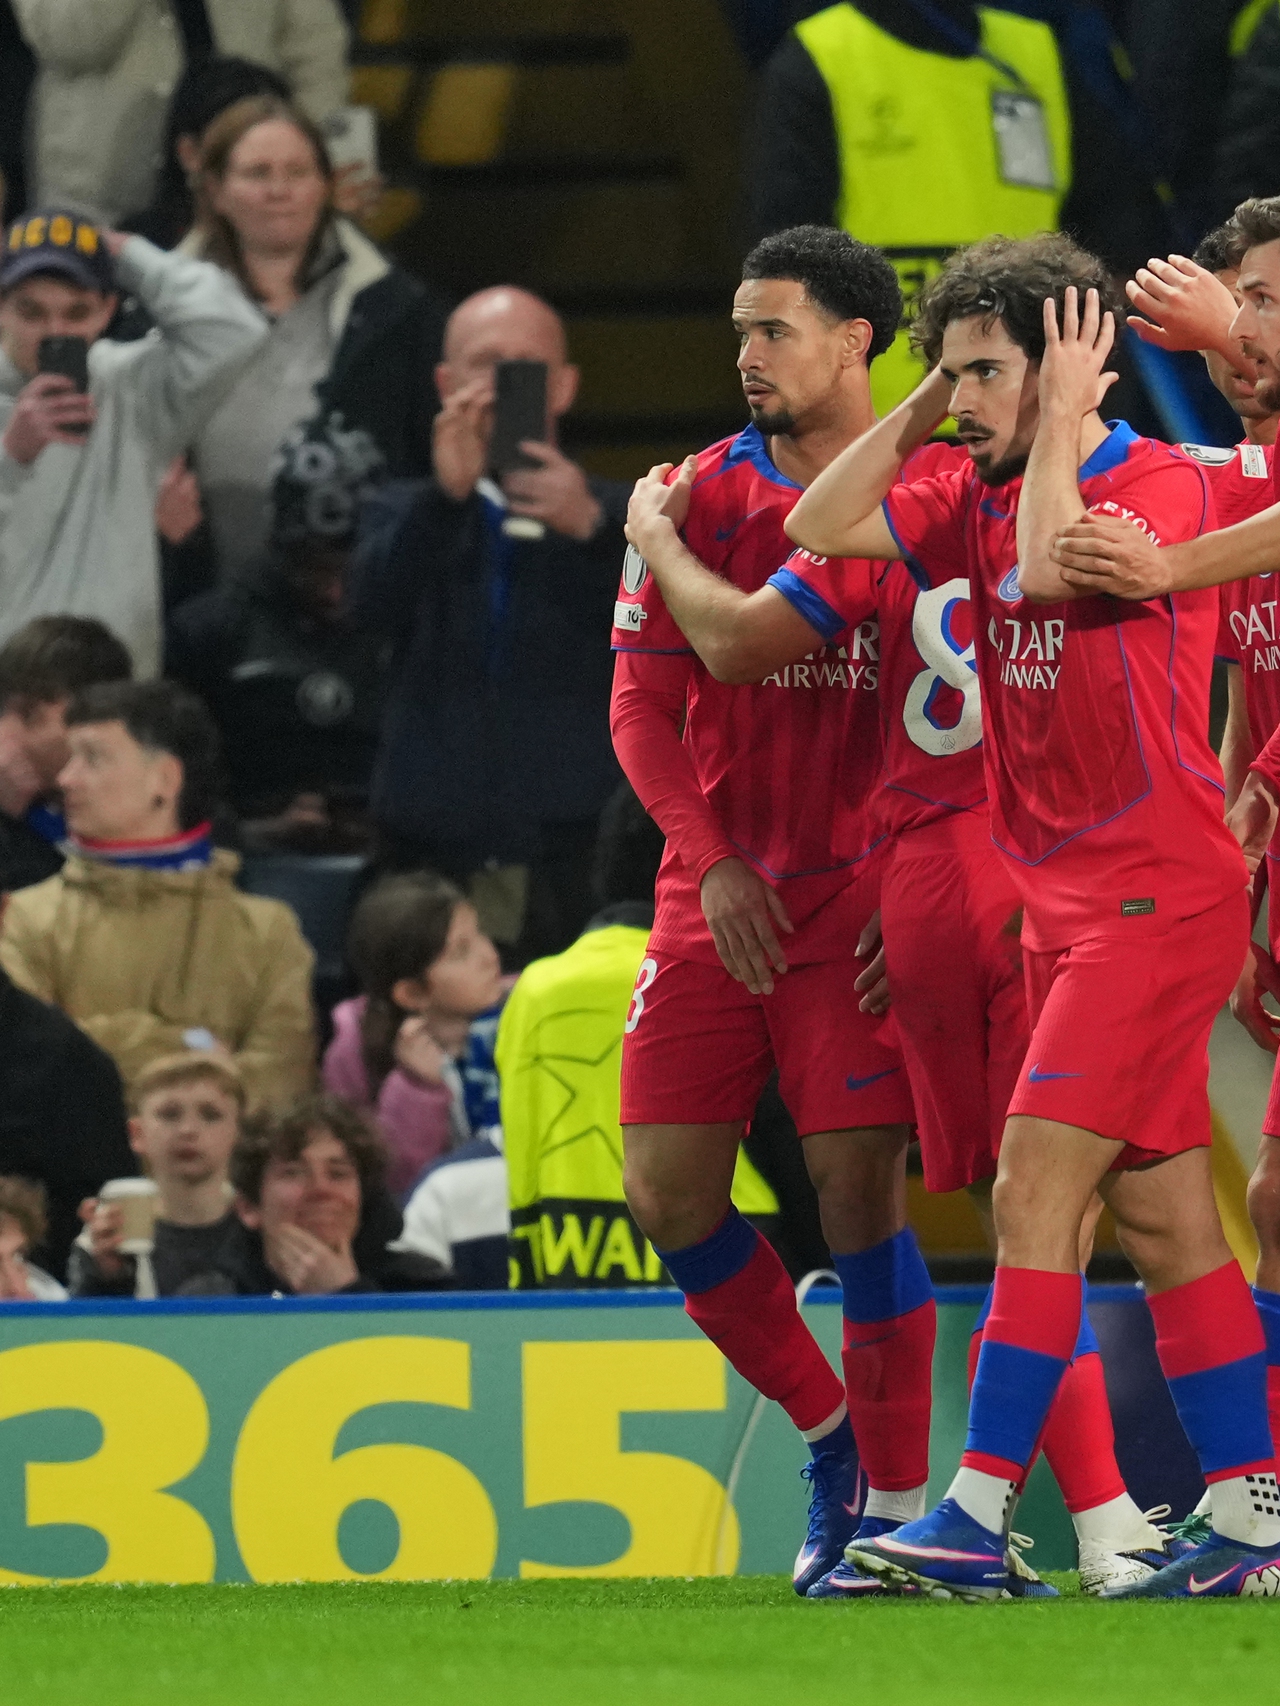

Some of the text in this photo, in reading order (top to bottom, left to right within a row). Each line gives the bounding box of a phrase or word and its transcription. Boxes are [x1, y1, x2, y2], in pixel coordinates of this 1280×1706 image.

[762, 662, 879, 691] AIRWAYS
[903, 578, 983, 756] 8
[0, 1335, 740, 1585] 365
